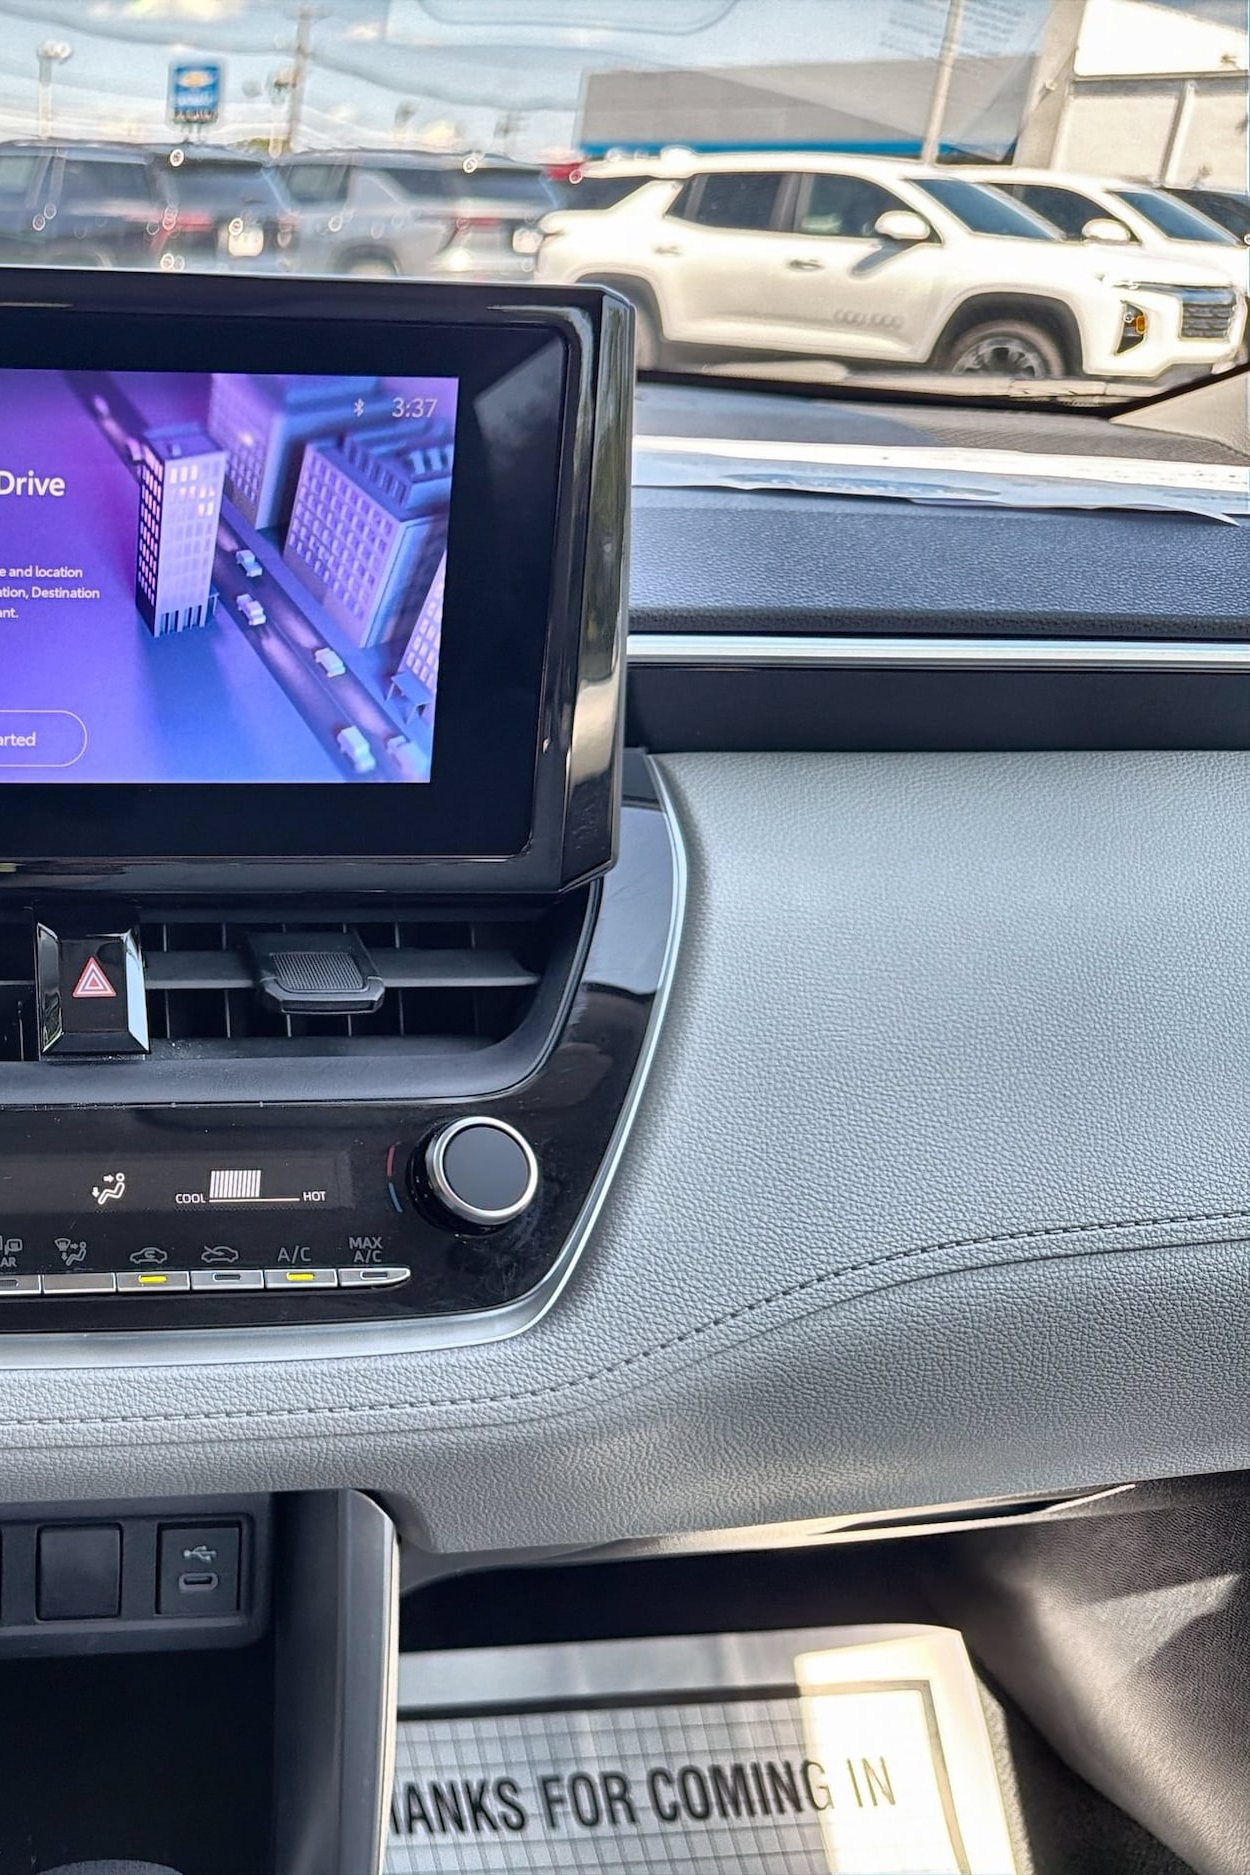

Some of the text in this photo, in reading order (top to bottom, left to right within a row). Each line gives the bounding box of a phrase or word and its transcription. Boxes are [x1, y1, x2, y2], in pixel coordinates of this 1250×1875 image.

[392, 396, 438, 418] 3:37
[9, 565, 33, 578] and
[35, 565, 84, 579] location
[31, 586, 101, 600] Destination
[175, 1193, 206, 1204] COOL
[303, 1191, 327, 1202] HOT
[349, 1236, 383, 1249] MAX
[277, 1246, 312, 1263] A/C
[353, 1250, 383, 1263] A/C
[538, 1769, 638, 1831] FOR
[646, 1758, 835, 1823] COMING
[847, 1755, 896, 1808] IN
